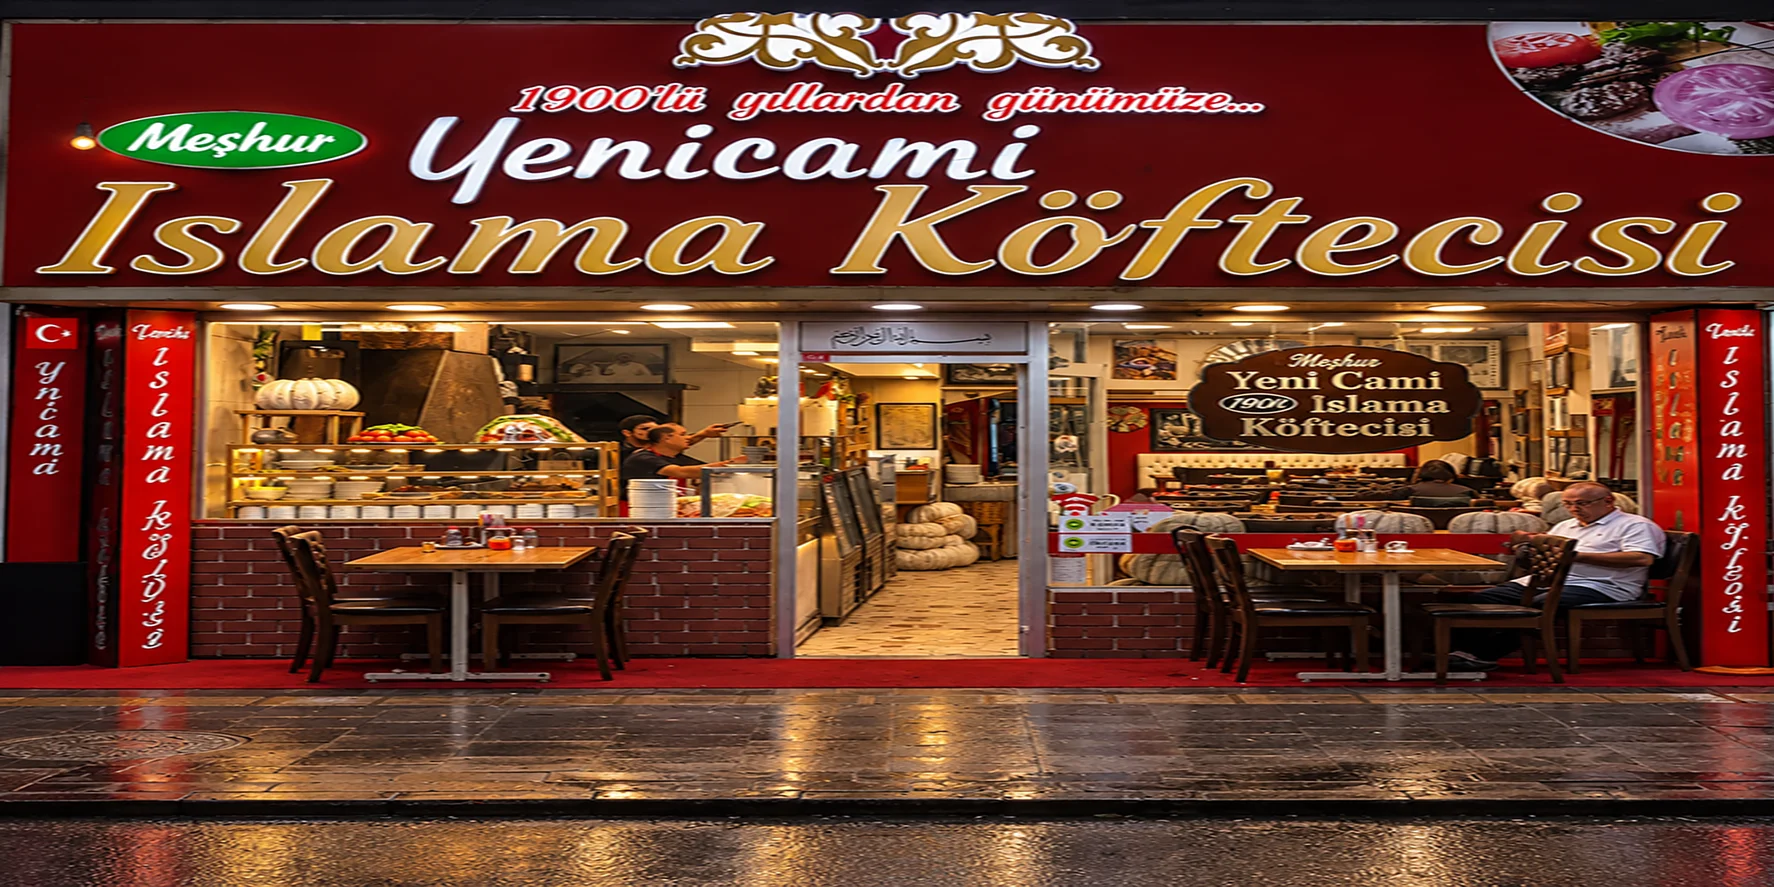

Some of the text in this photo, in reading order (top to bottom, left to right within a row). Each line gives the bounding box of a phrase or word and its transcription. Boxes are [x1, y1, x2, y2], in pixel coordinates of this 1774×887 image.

[509, 82, 1265, 121] 1900'lü yıllardan günümüze...
[126, 122, 335, 158] Meşhur
[409, 115, 1040, 204] Yenicami
[36, 177, 1741, 281] Islama Köftecisi
[1226, 371, 1443, 390] Yeni Cami
[1239, 417, 1434, 437] Köftecisi
